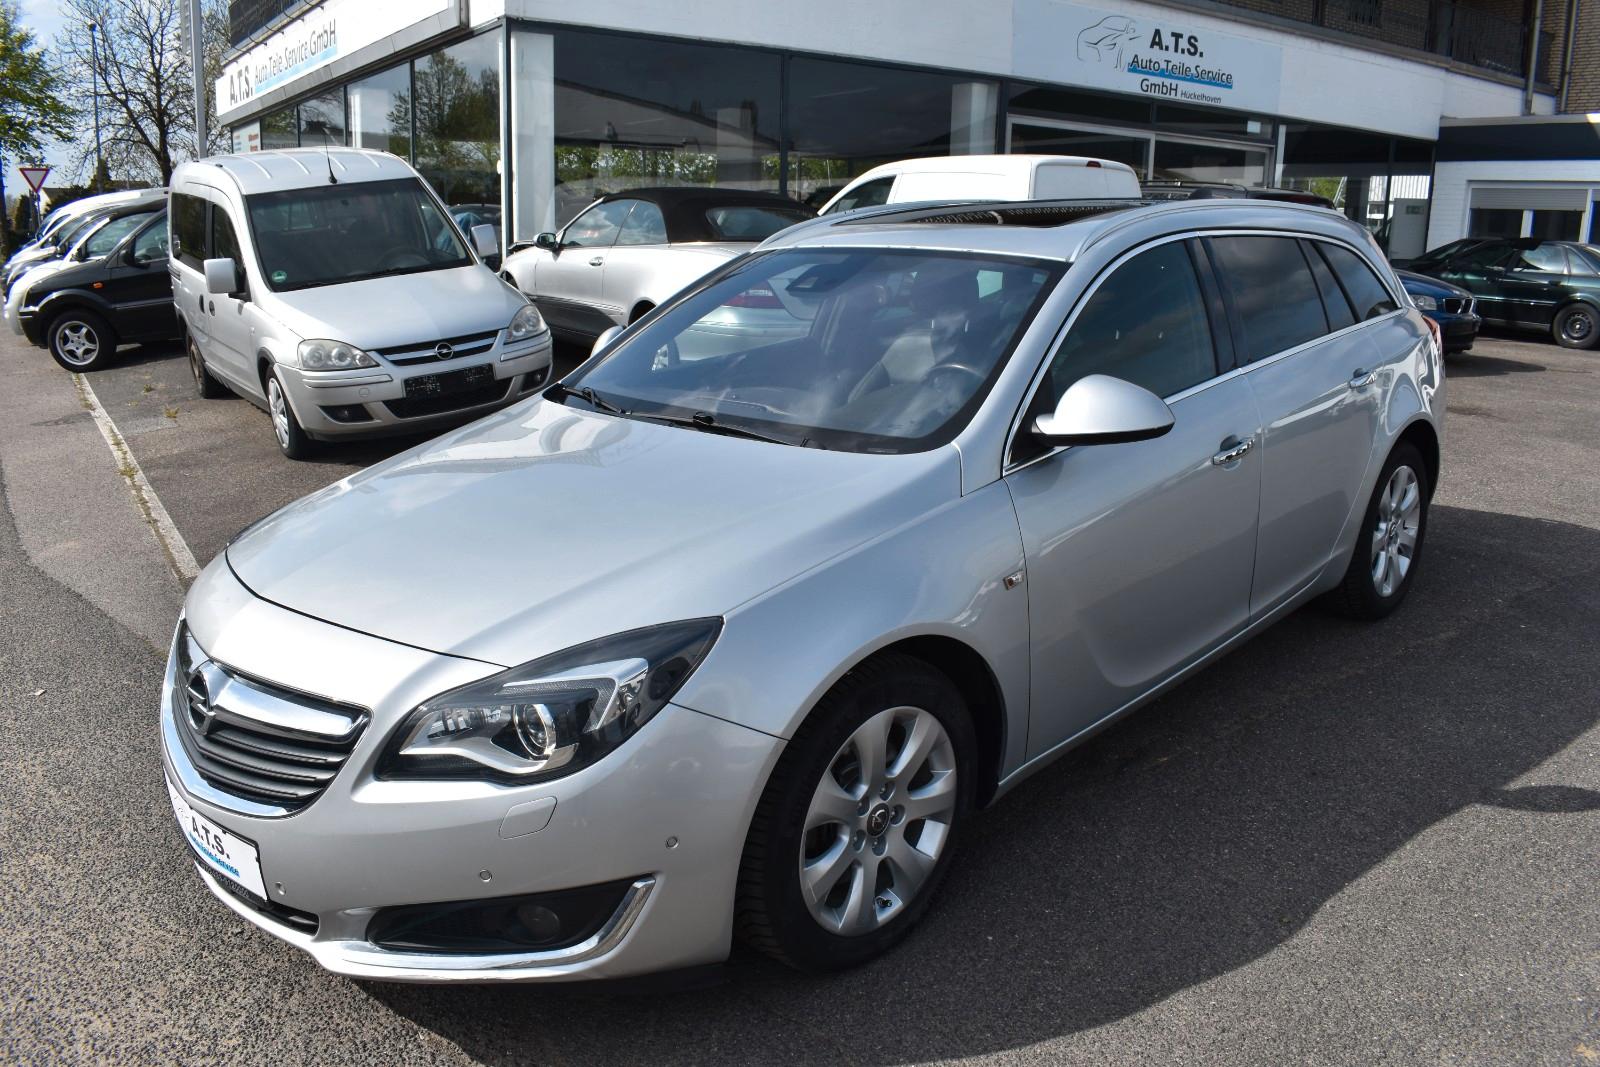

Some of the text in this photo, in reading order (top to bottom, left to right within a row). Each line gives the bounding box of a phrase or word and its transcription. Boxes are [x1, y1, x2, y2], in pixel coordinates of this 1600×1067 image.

[1150, 29, 1204, 58] A.T.S.
[230, 65, 253, 106] A.T.S.
[284, 40, 308, 70] Service
[310, 18, 336, 56] GmbH
[1130, 54, 1233, 85] Auto Teile Service
[1140, 78, 1178, 97] GmbH
[191, 815, 231, 860] A.T.S.
